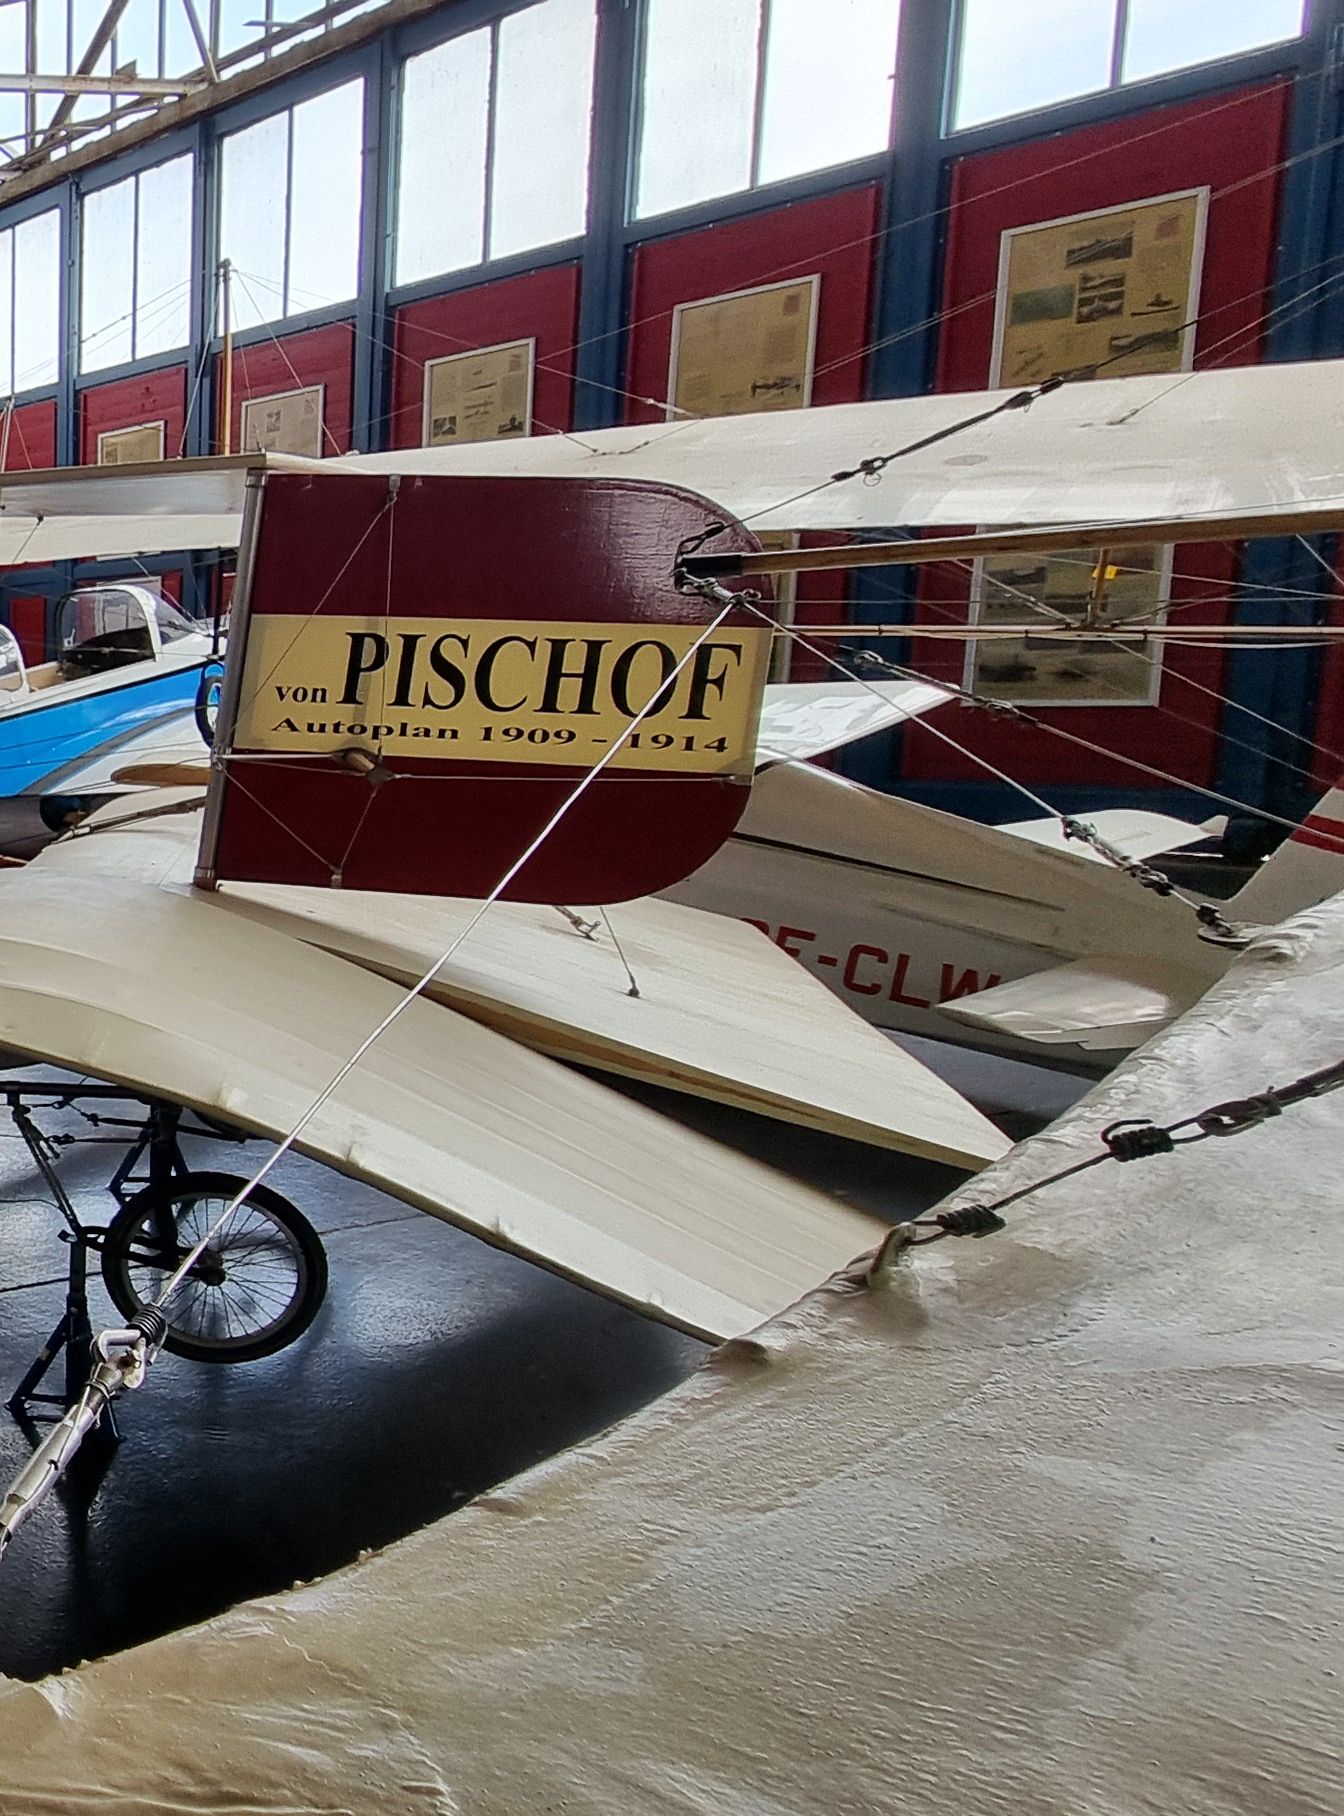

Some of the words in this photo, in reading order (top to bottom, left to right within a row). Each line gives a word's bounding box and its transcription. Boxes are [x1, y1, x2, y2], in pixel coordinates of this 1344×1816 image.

[274, 686, 327, 703] von
[335, 632, 743, 720] PISCHOF
[271, 717, 459, 741] Autoplan
[478, 726, 577, 746] 1909
[625, 732, 729, 753] 1914
